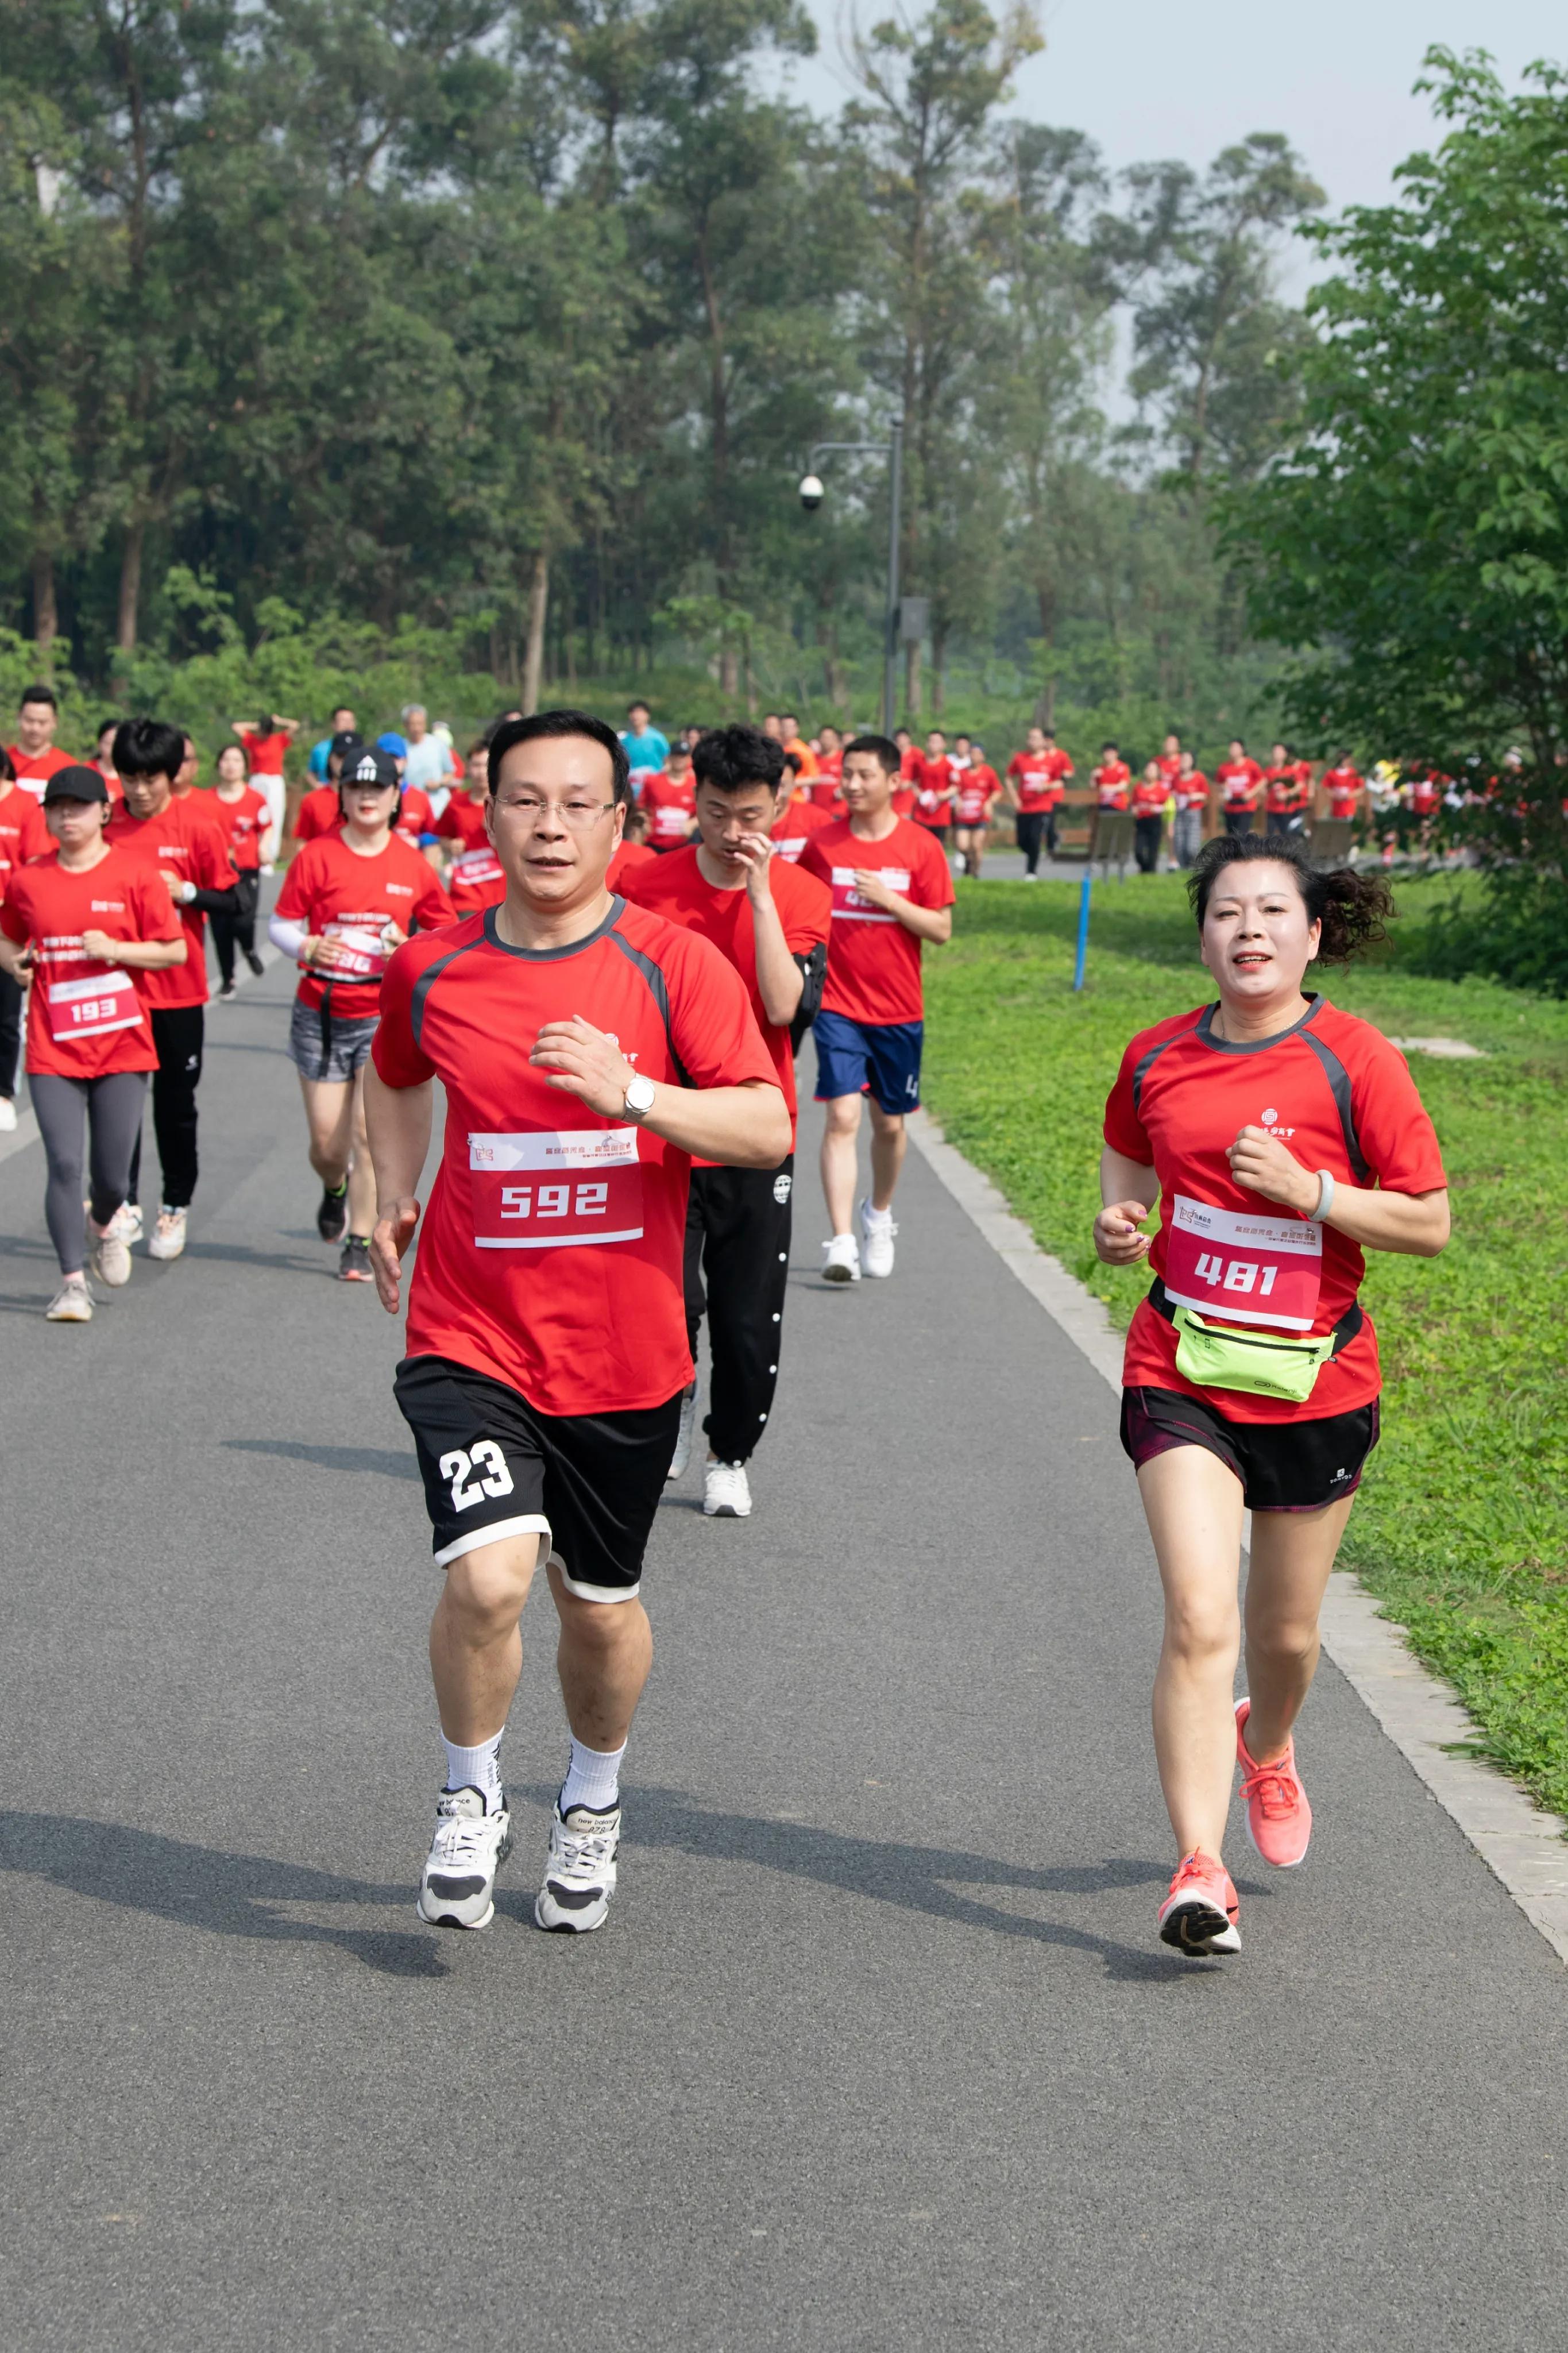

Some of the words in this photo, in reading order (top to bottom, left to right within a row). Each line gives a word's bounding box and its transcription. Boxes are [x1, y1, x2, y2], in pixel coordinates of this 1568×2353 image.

[71, 997, 117, 1023] 193
[500, 1182, 608, 1218] 592
[1194, 1252, 1278, 1296] 481
[439, 1439, 515, 1513] 23
